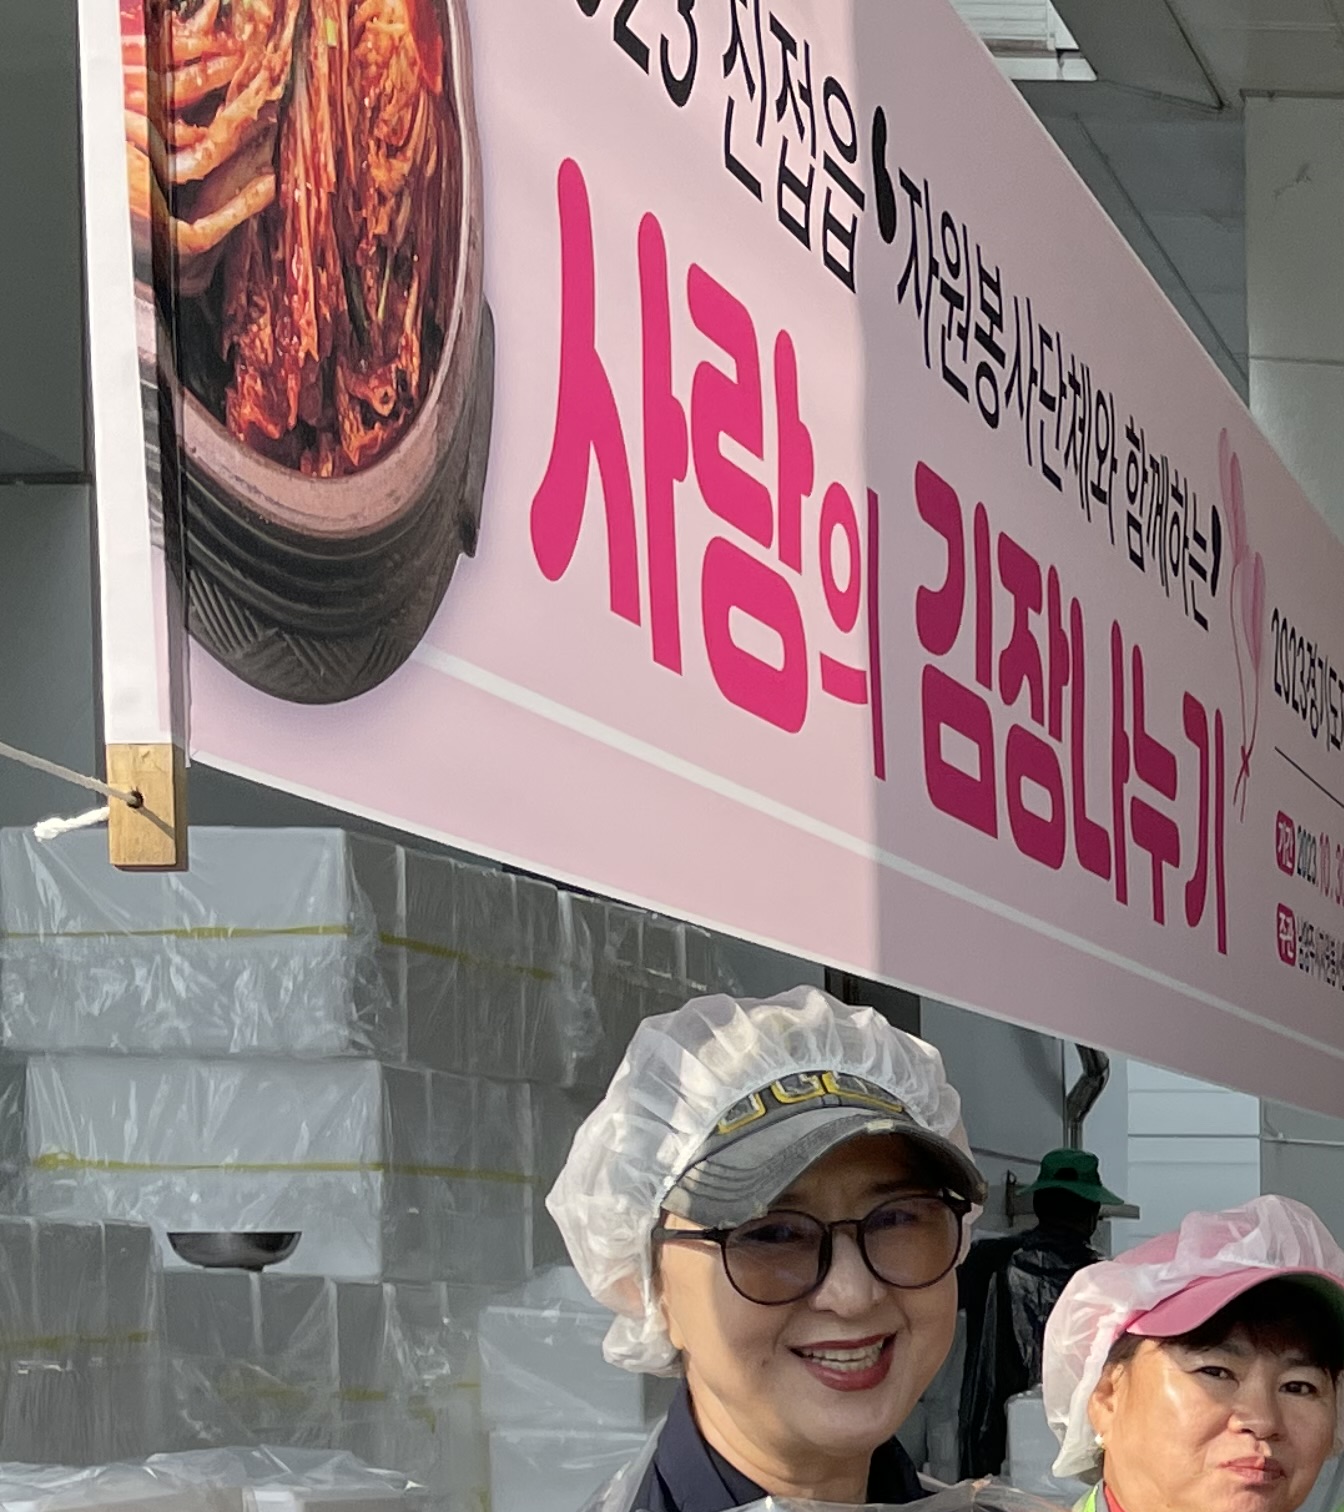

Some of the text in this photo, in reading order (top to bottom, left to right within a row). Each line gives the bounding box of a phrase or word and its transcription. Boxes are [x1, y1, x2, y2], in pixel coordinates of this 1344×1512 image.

[722, 0, 865, 294] 진접읍
[530, 157, 1229, 955] 사랑의 김장나누기
